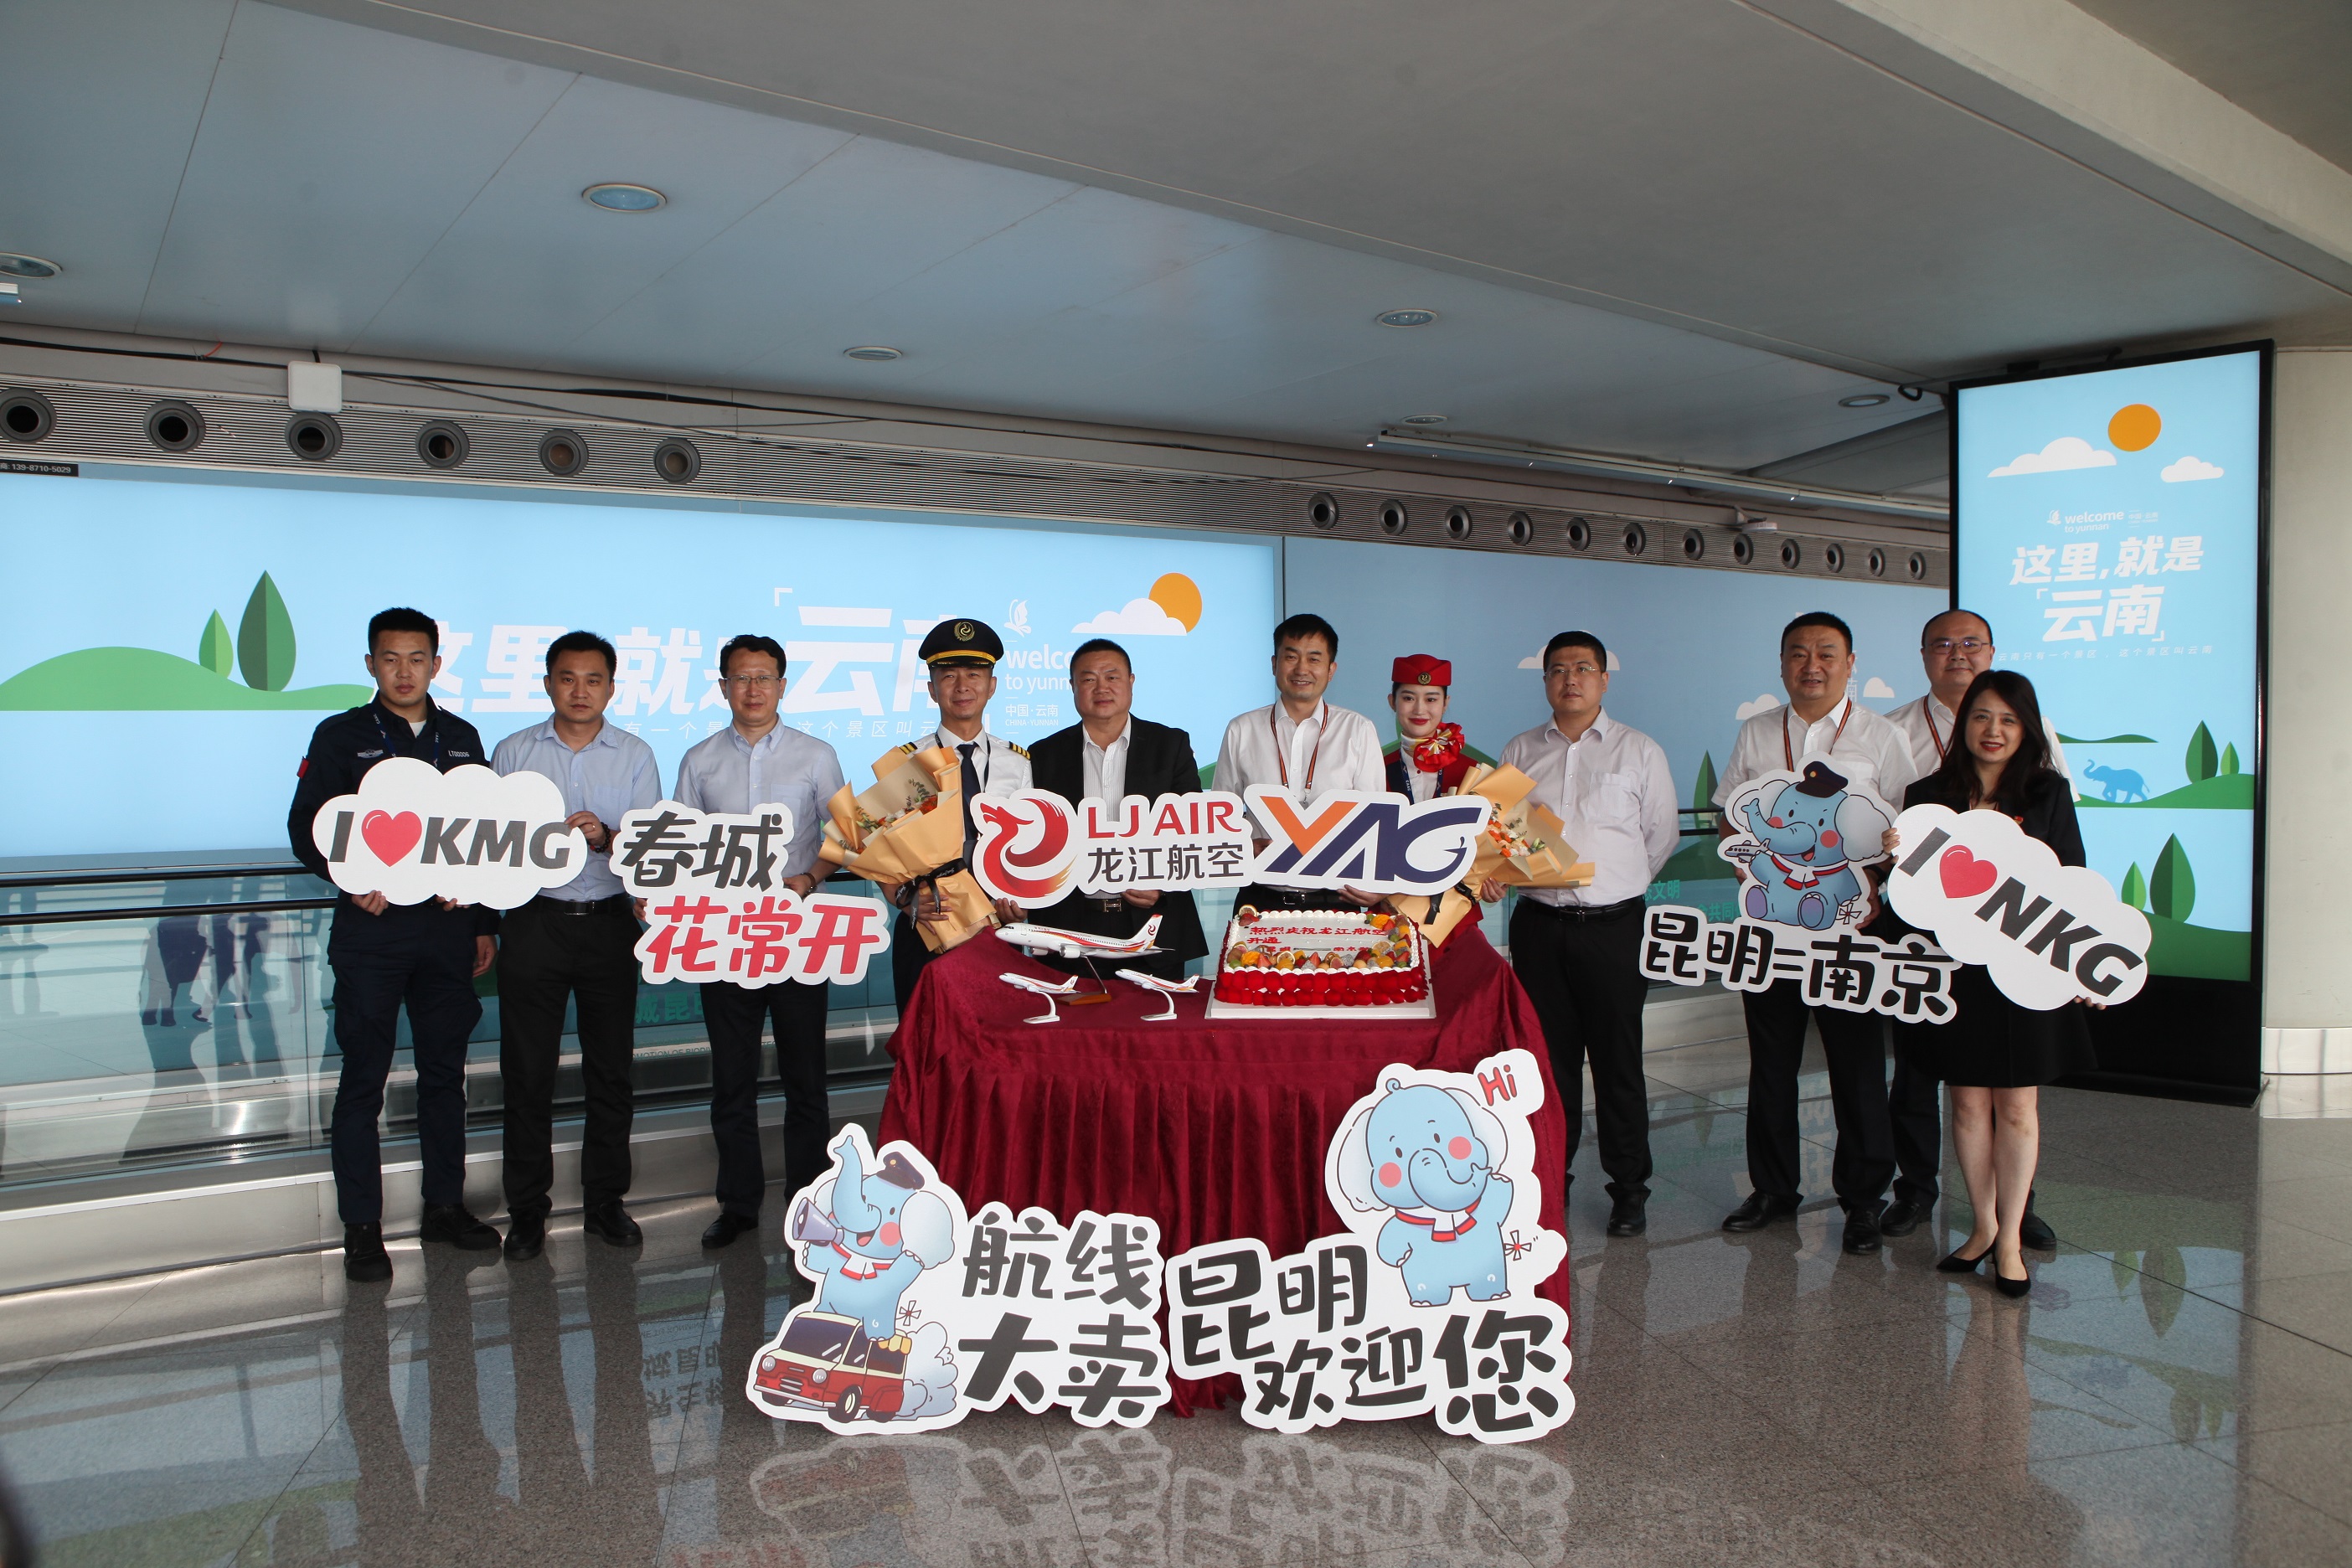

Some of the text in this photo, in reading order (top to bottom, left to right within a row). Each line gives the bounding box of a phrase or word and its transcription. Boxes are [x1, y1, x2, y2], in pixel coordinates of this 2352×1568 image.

[12, 463, 71, 473] 139-8710-5029
[2064, 524, 2110, 534] to yunnan
[2065, 509, 2124, 524] welcome
[1004, 673, 1023, 690] to
[1005, 704, 1059, 717] 中国·云南
[329, 811, 574, 869] I KMG
[1154, 801, 1243, 837] AIR
[1260, 795, 1483, 883] YAG
[621, 810, 784, 893] 春城
[1087, 842, 1245, 884] 龙江航空
[646, 895, 880, 978] 花常开
[1897, 826, 2143, 998] I NKG
[1479, 1063, 1516, 1107] Hi
[962, 1215, 1154, 1312] 航线
[1175, 1244, 1369, 1366] 昆明
[957, 1313, 1161, 1417] 大卖
[1251, 1311, 1559, 1431] 欢迎您
